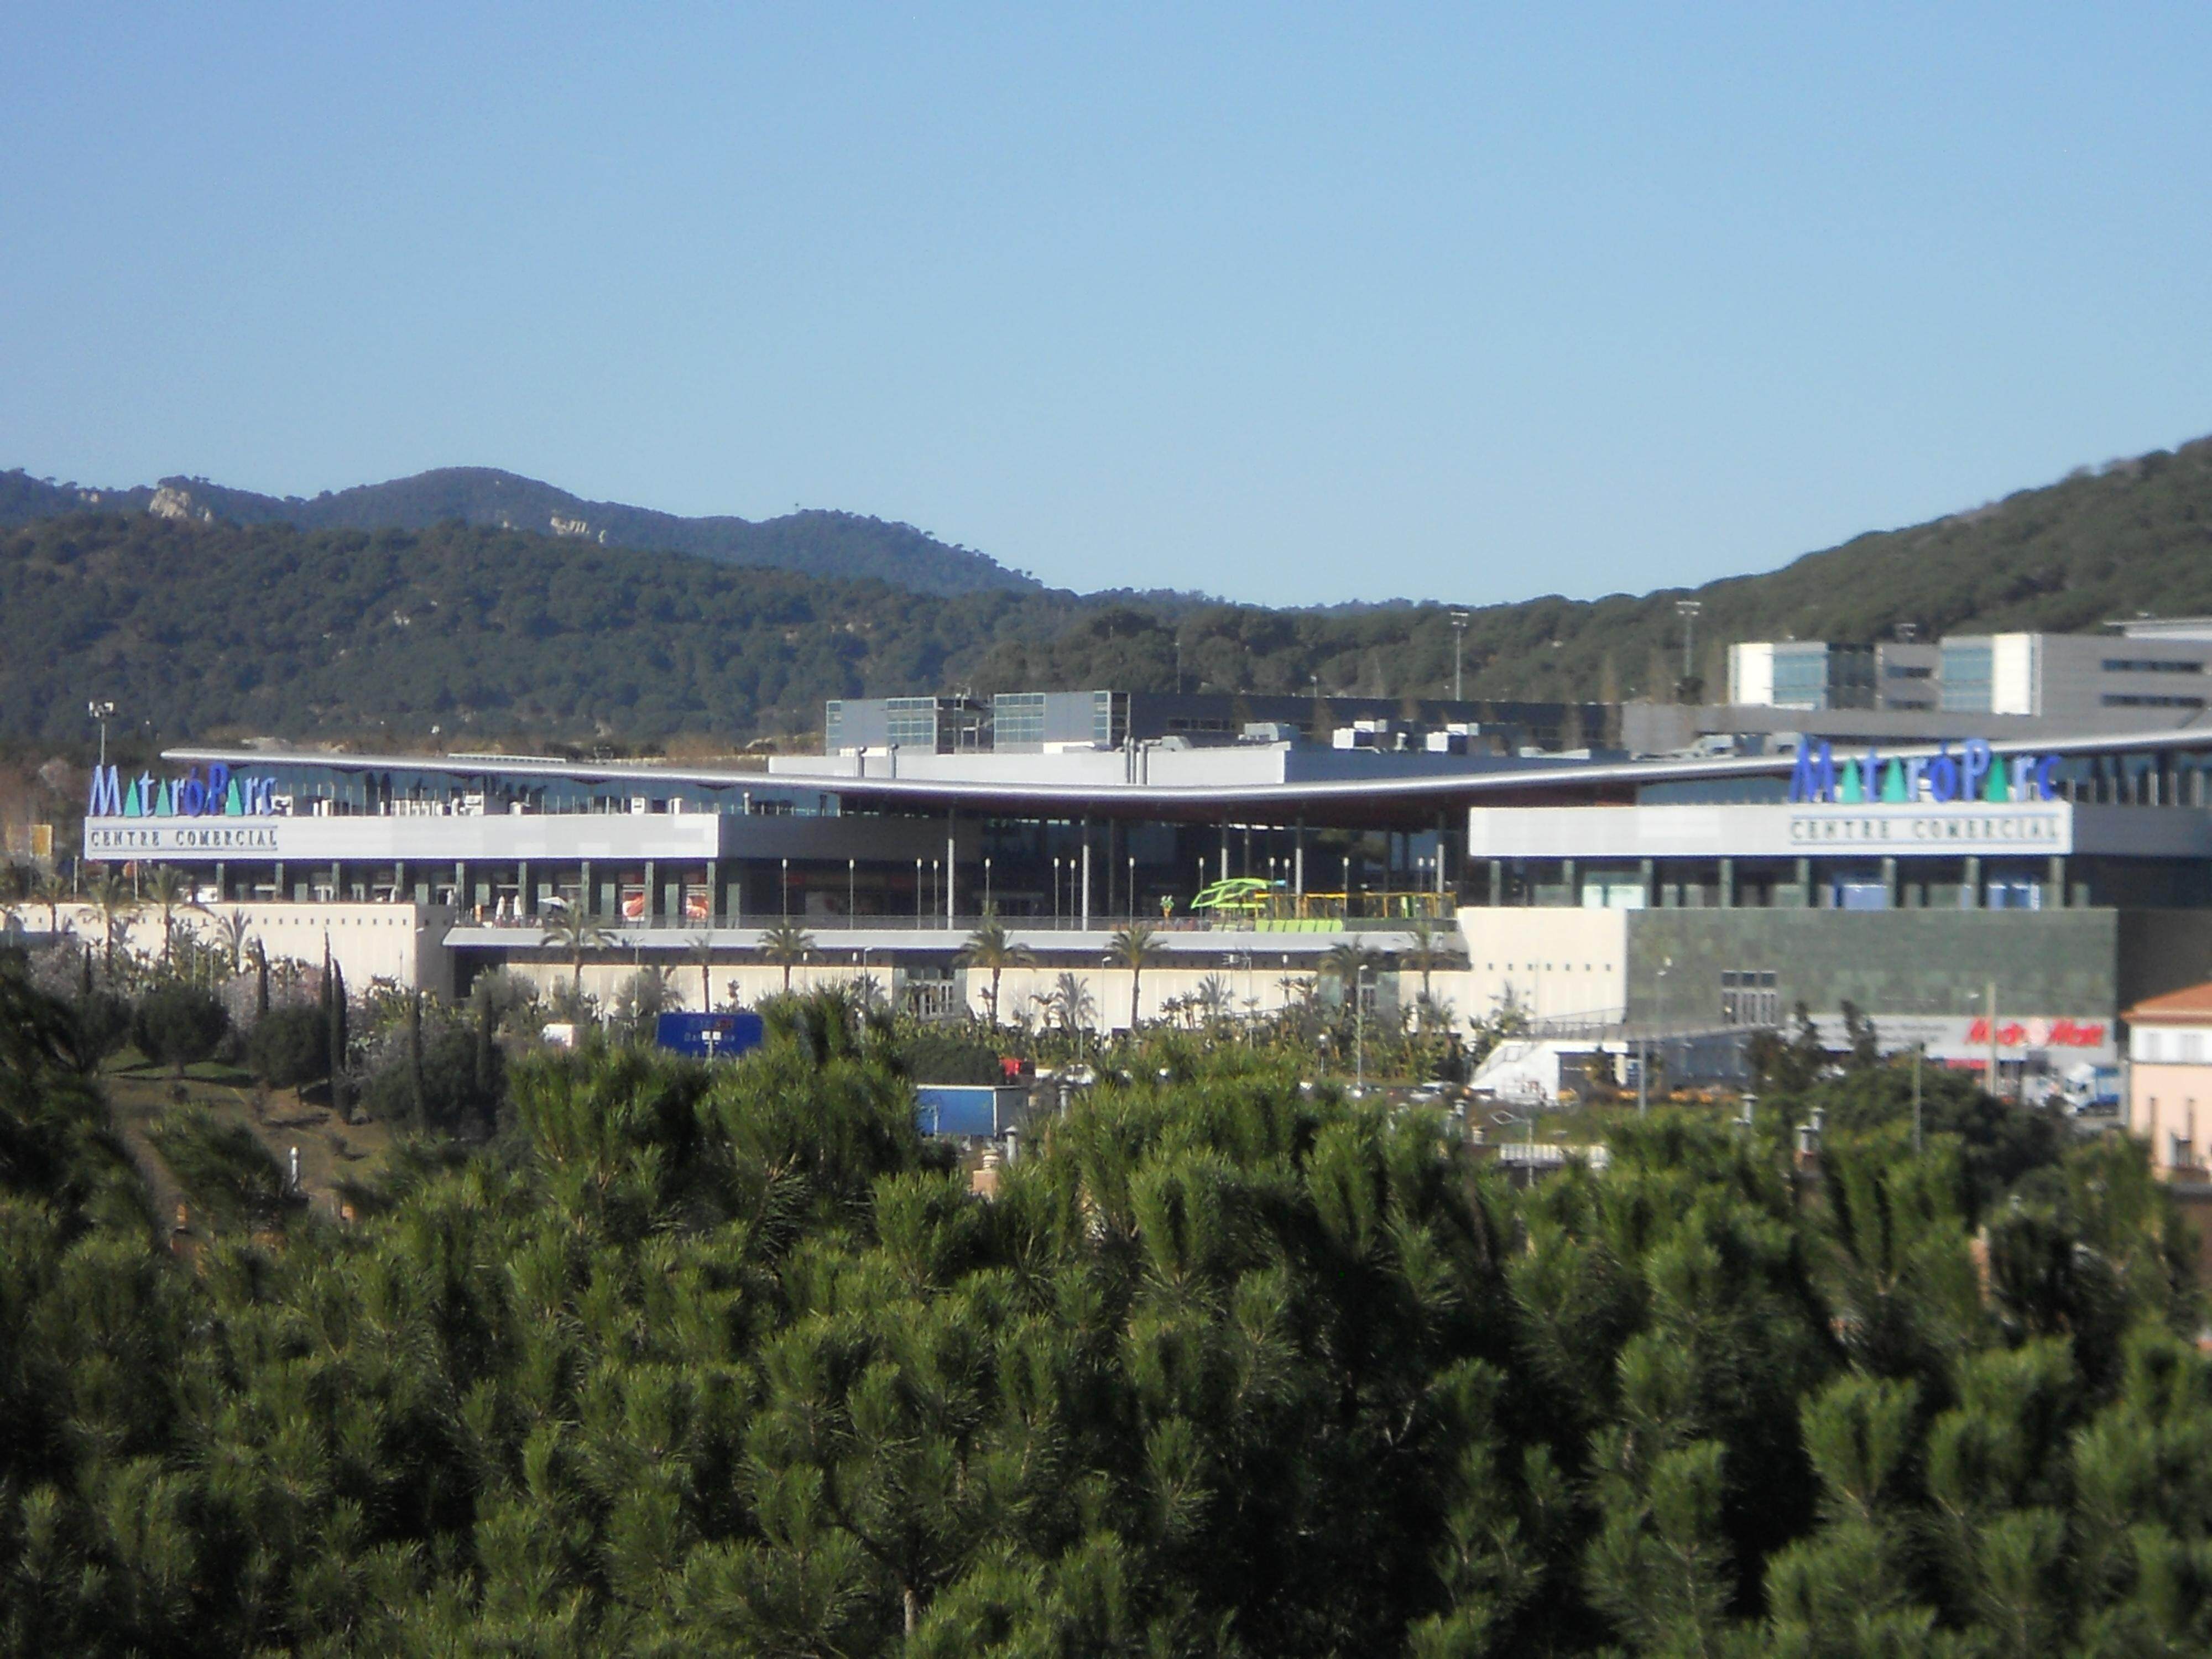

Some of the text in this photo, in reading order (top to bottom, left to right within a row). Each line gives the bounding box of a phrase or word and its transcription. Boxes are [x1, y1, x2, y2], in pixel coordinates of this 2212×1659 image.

[90, 830, 278, 847] CENTRE COMERCIAL
[1790, 818, 2060, 841] CENTRE COMERCIAL
